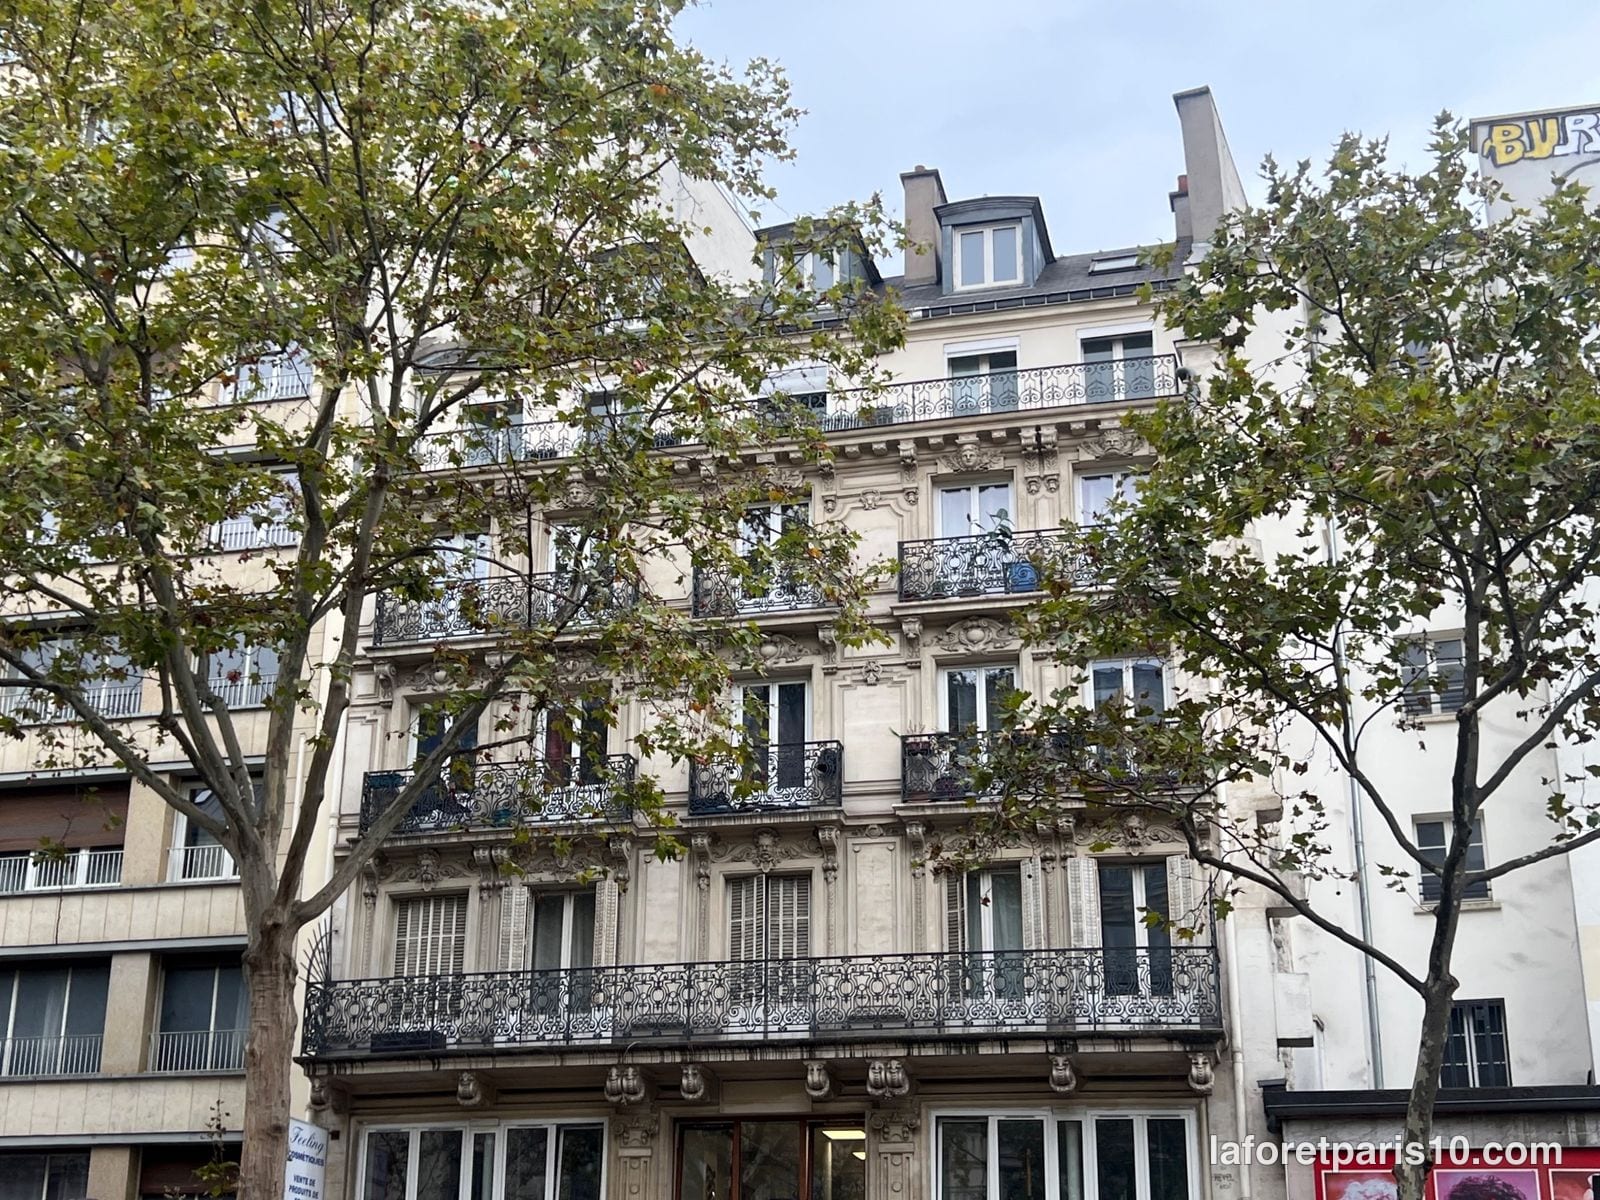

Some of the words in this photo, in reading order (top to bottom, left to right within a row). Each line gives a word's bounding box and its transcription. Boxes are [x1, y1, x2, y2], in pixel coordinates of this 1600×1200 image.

[1481, 112, 1600, 168] BUR
[291, 1126, 325, 1155] Feeling
[293, 1174, 309, 1185] VENTE
[309, 1178, 316, 1187] DE
[288, 1185, 312, 1198] PRODUITS
[312, 1190, 319, 1199] DE
